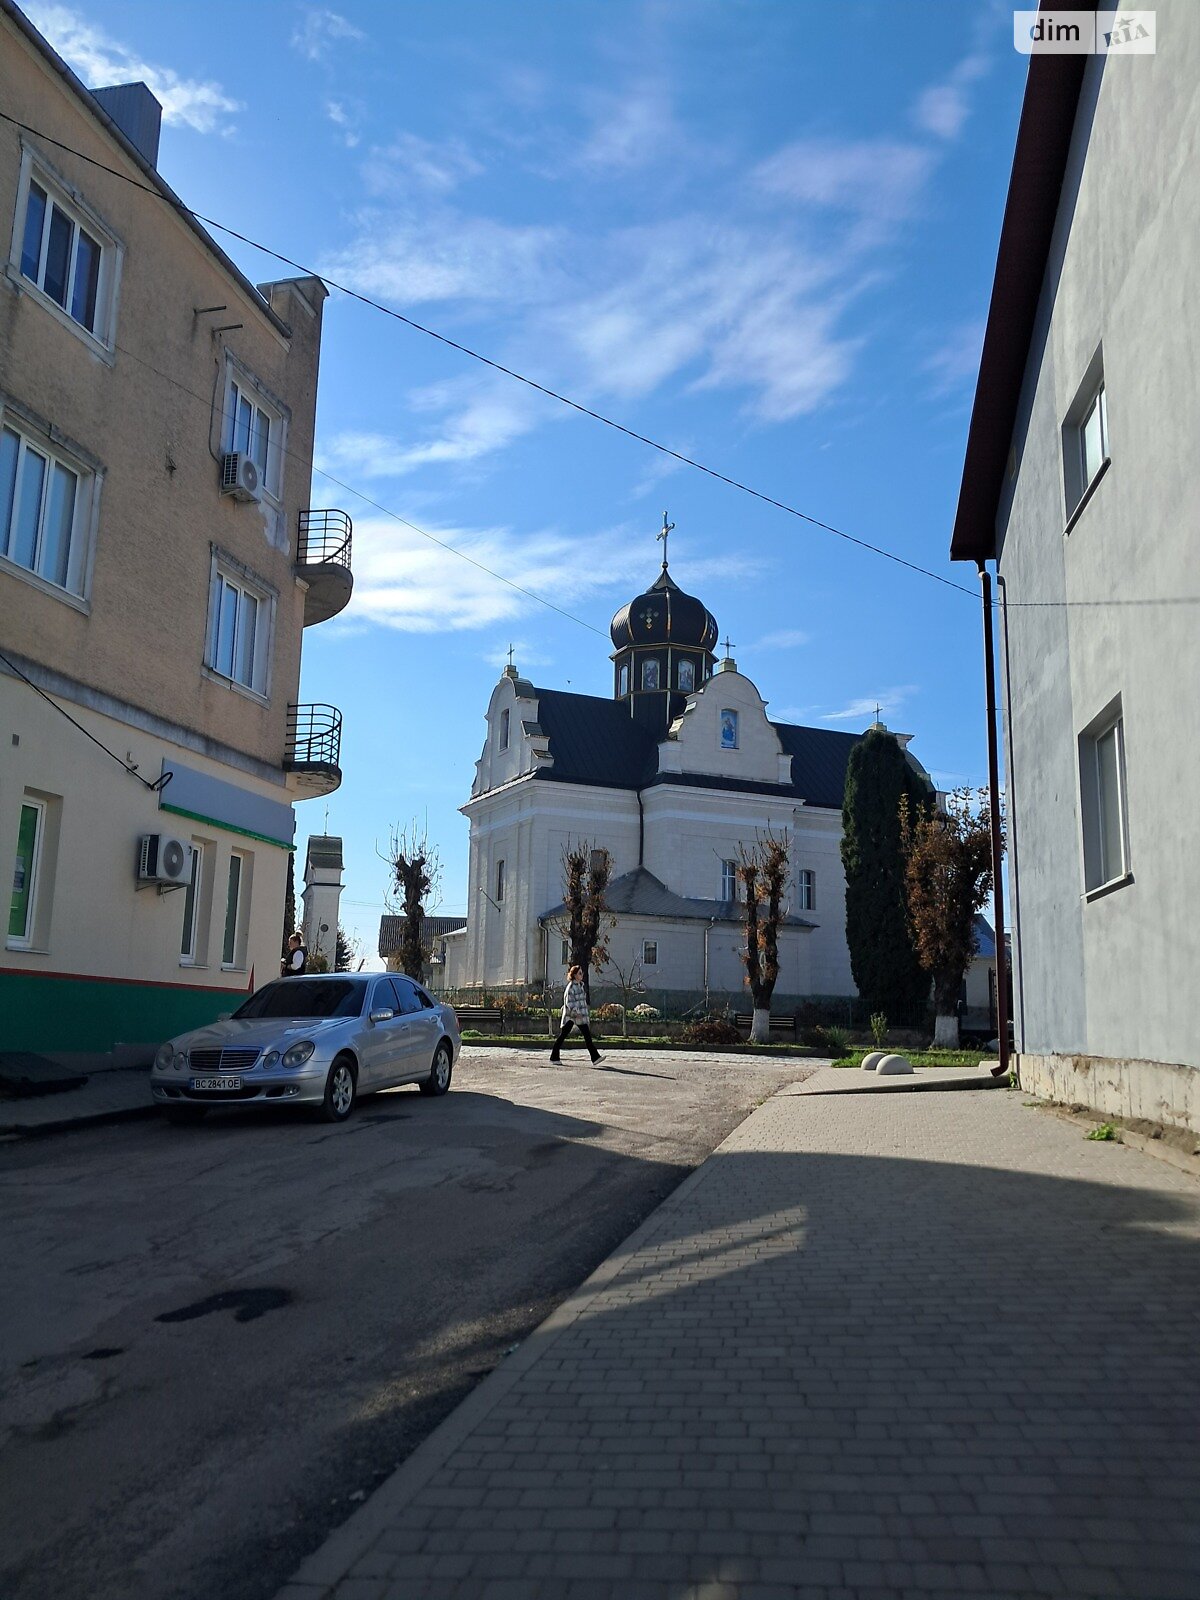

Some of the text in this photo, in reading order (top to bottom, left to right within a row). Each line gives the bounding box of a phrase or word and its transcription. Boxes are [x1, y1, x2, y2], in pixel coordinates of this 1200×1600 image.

[195, 1079, 240, 1089] BC 2841 OE
